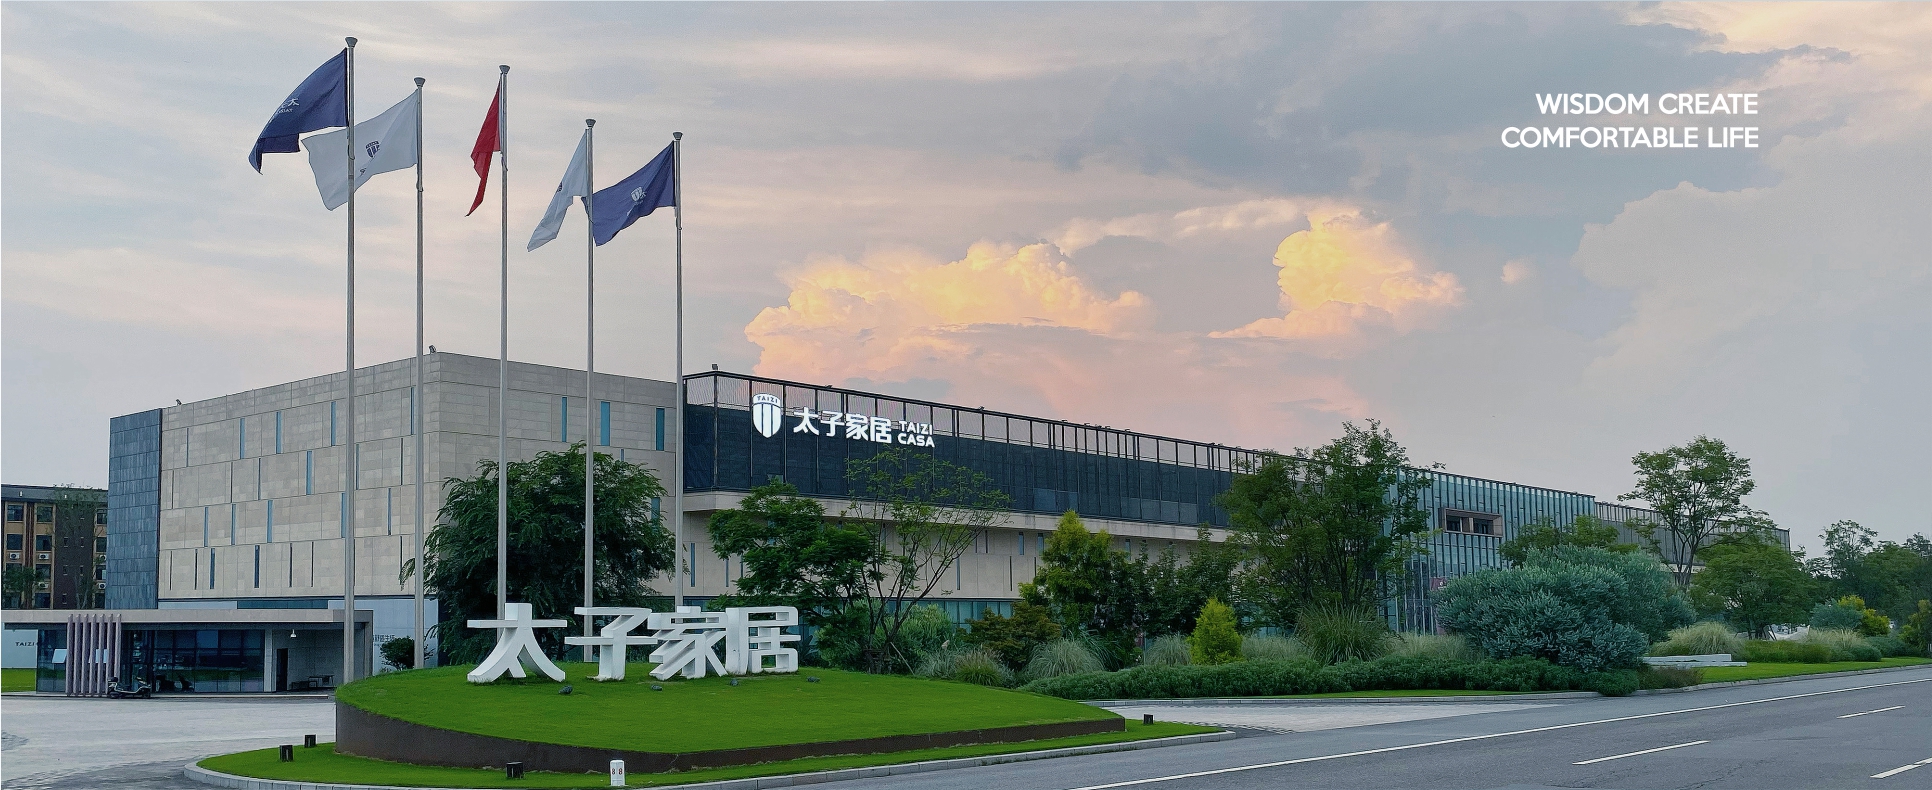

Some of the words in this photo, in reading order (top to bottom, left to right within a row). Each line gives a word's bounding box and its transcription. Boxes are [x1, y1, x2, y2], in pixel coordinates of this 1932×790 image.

[756, 395, 778, 404] TAIZI
[793, 406, 892, 444] 太子家居
[898, 420, 933, 436] TAIZI
[897, 433, 936, 448] CASA
[467, 602, 801, 682] 太子家居
